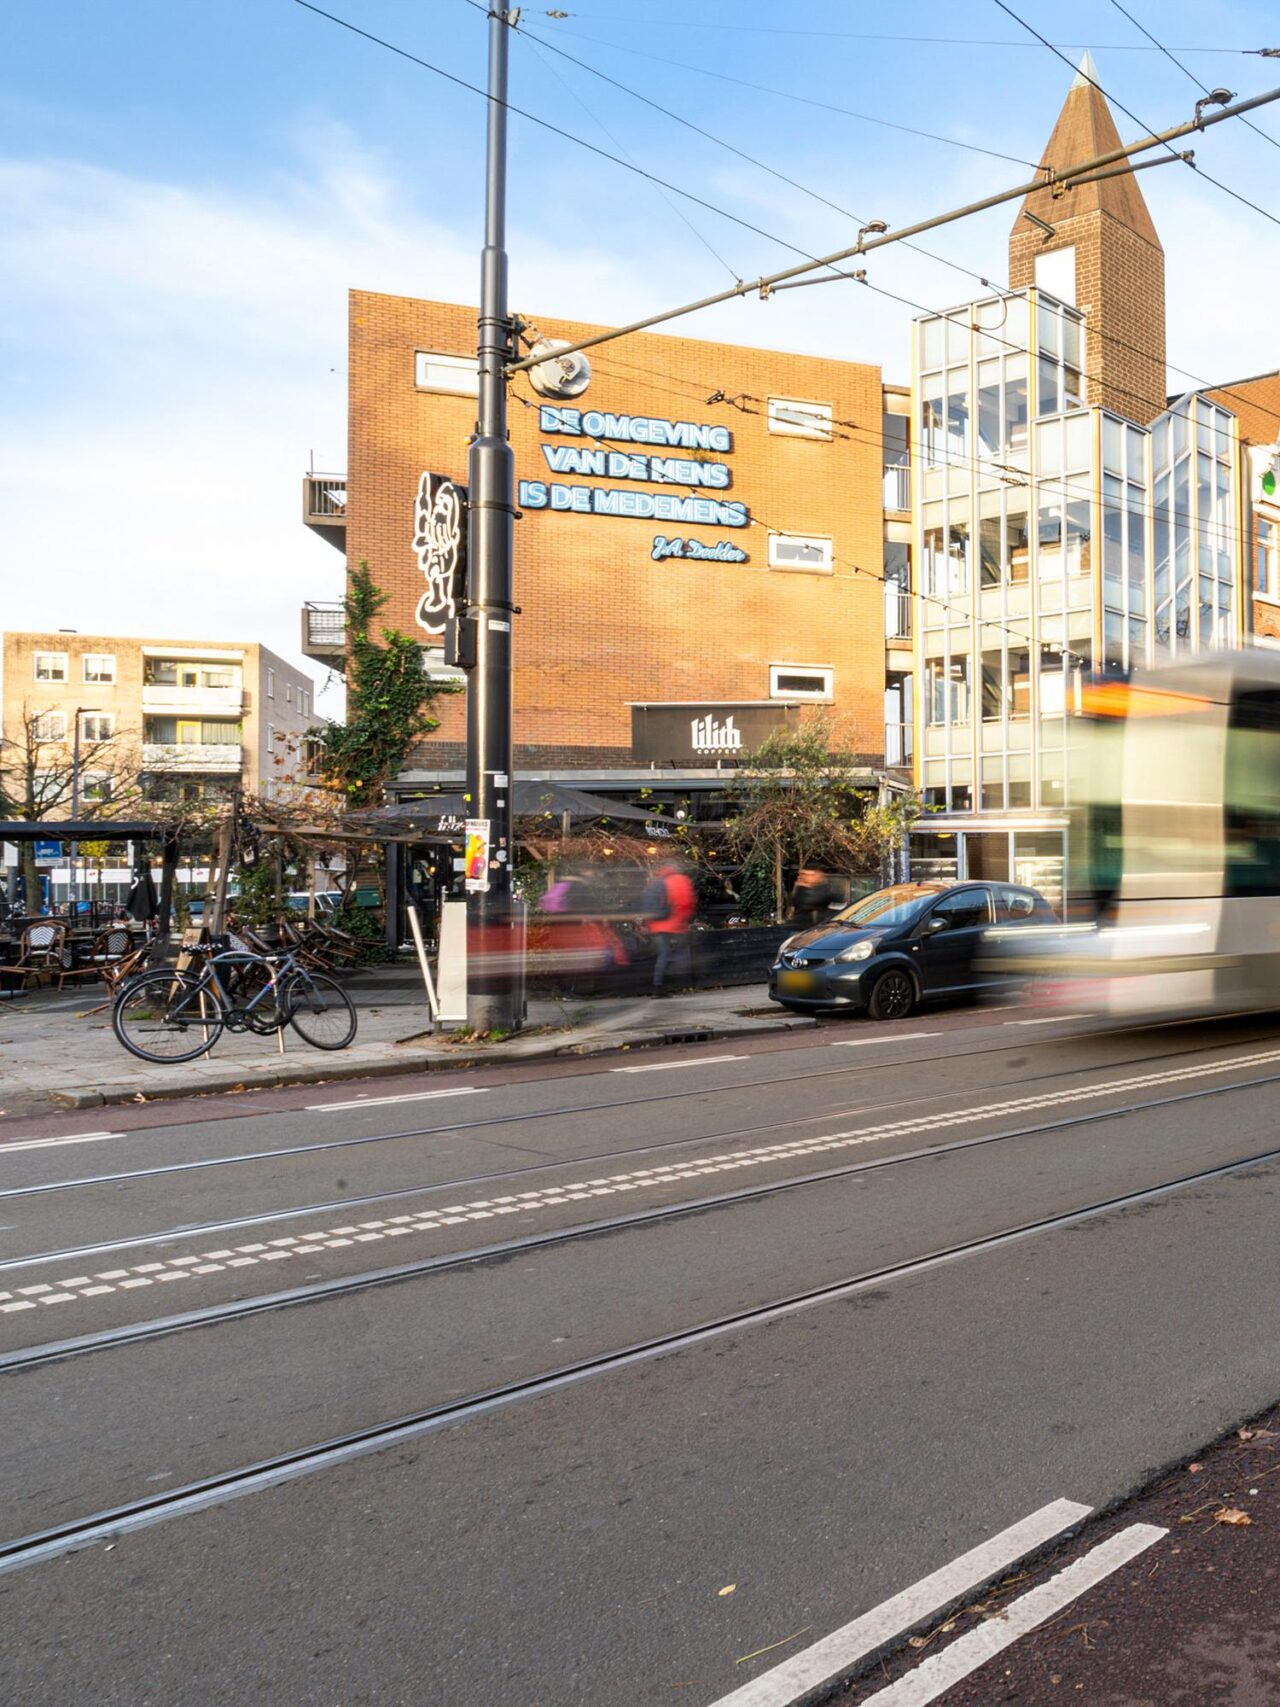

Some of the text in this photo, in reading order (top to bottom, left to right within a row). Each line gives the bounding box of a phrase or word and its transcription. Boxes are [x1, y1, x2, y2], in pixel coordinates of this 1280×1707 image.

[539, 405, 731, 451] DE OMGEVING
[541, 444, 730, 488] VAN DE MENS
[519, 480, 748, 527] IS DE MEDEMENS
[652, 536, 746, 562] J.A. Deelder
[691, 714, 743, 750] lilith
